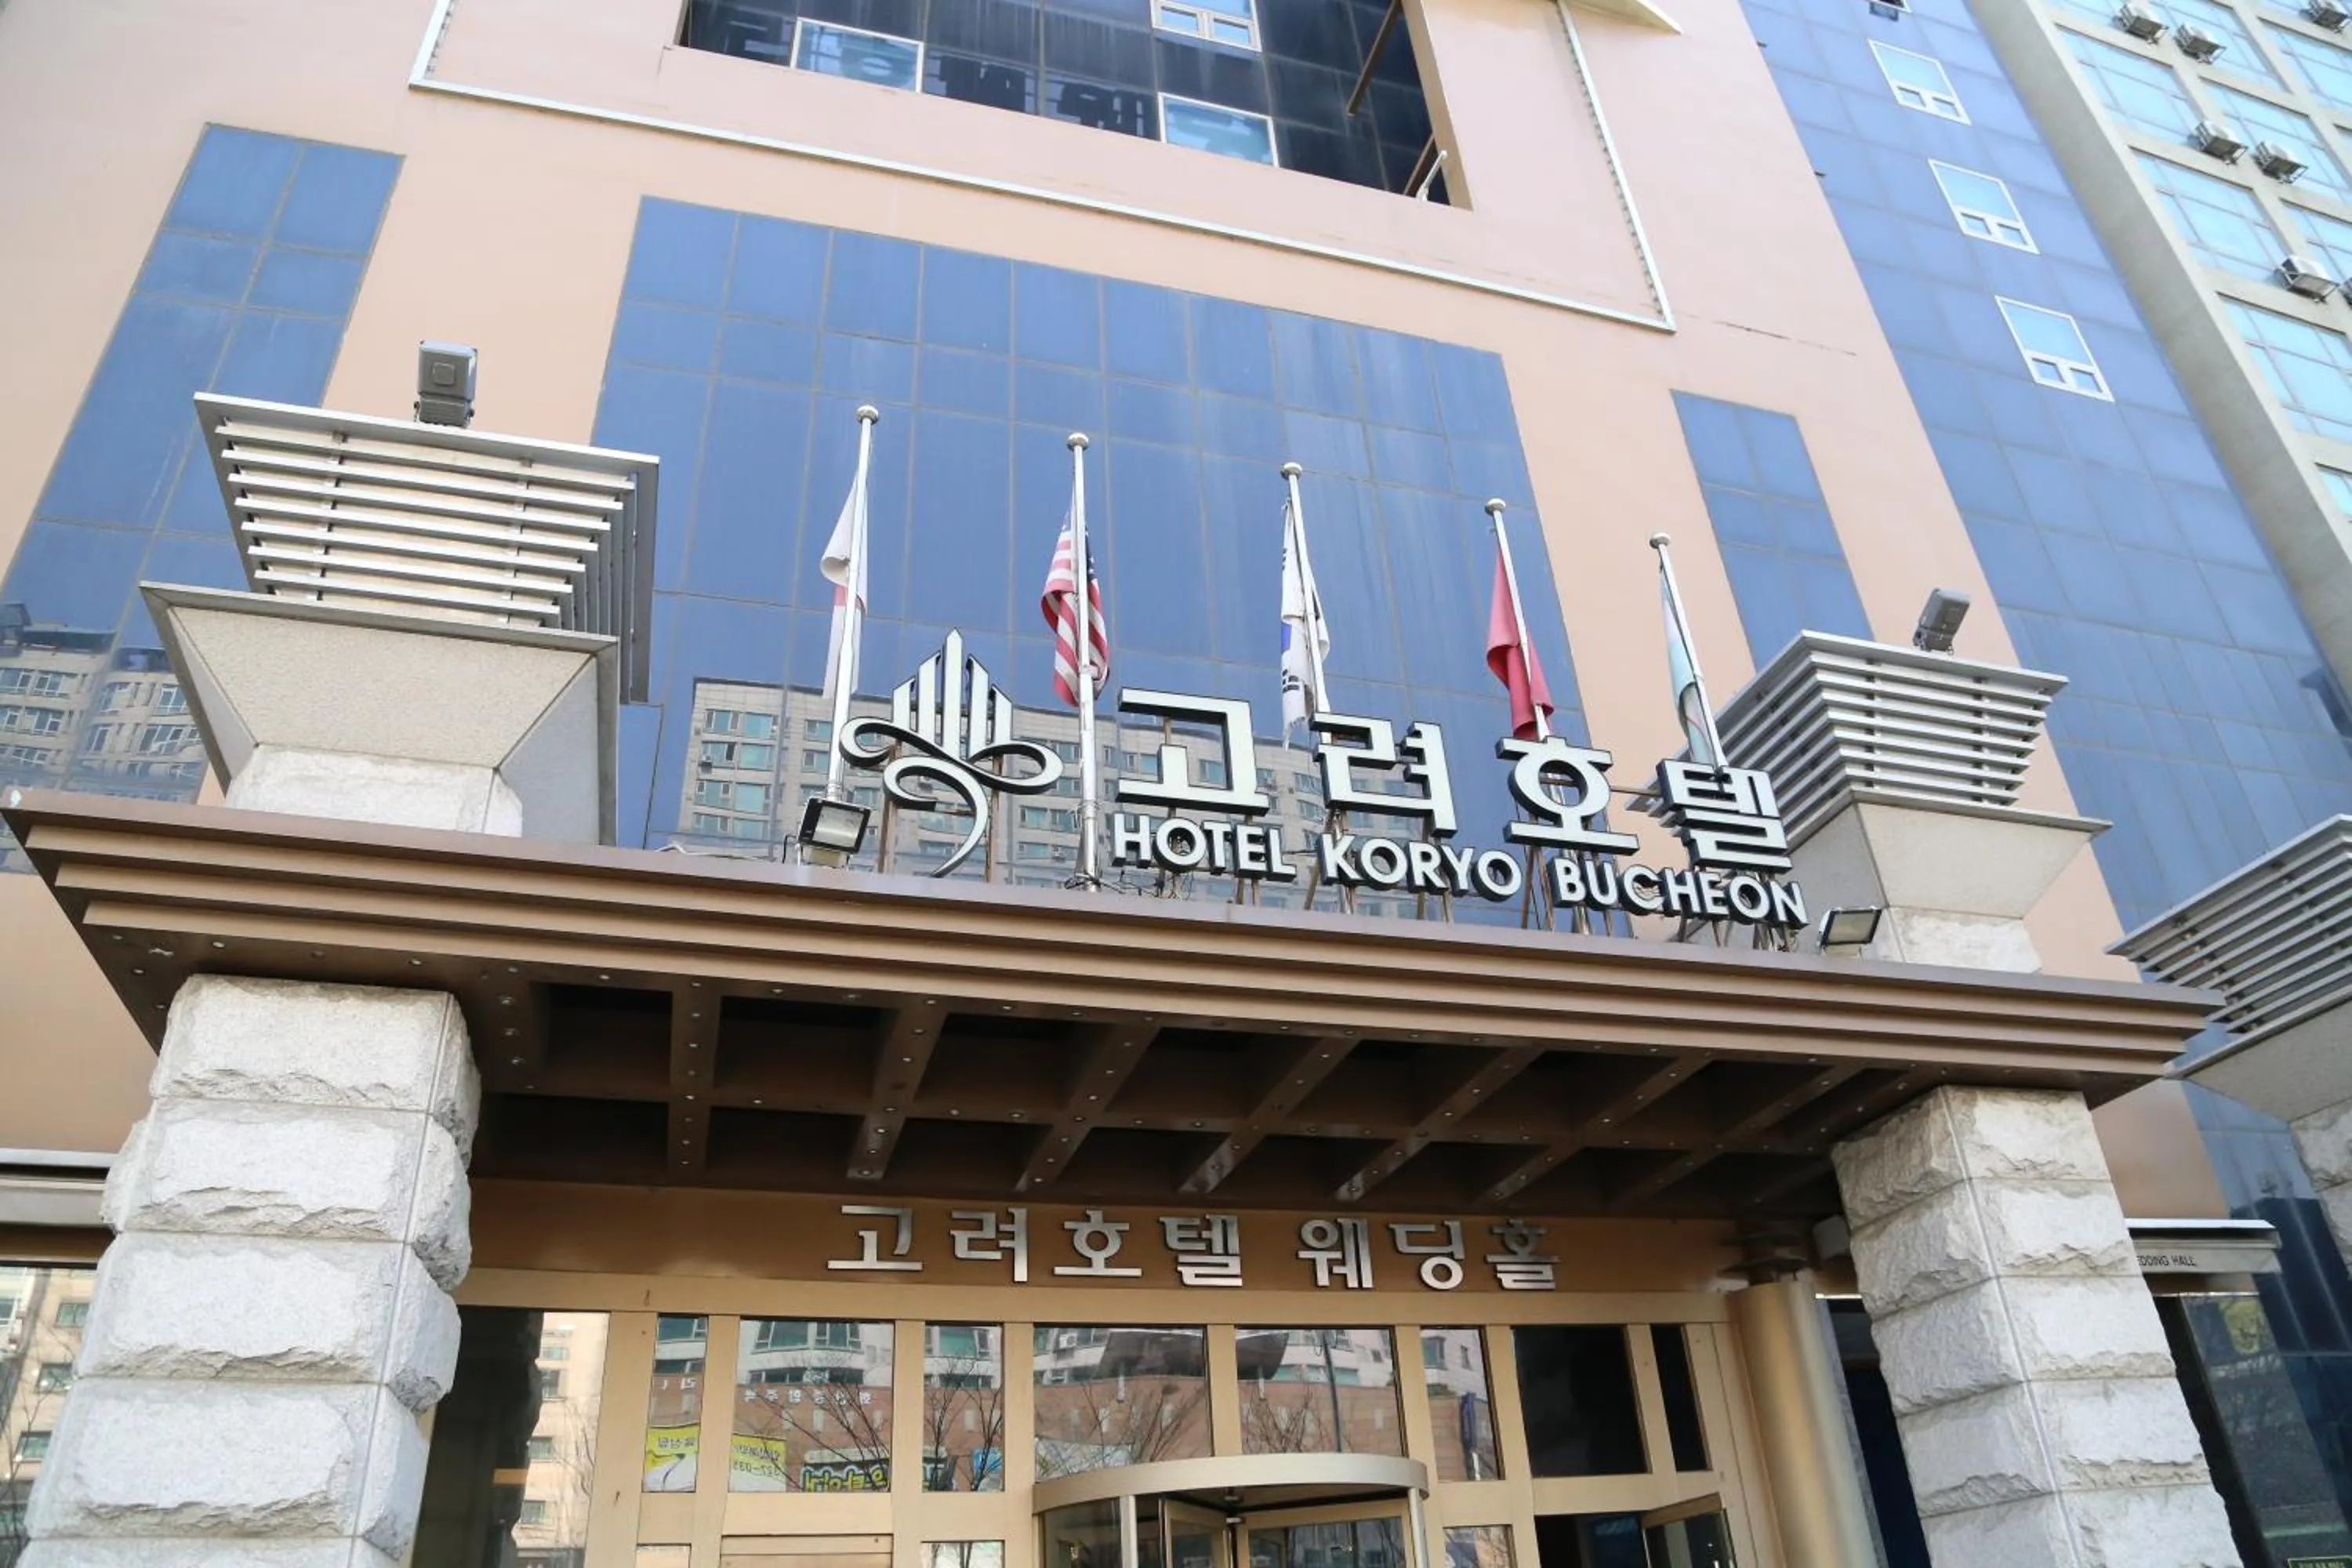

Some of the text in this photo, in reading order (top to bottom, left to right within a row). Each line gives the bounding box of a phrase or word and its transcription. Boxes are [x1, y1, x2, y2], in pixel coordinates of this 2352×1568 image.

[1116, 688, 1792, 873] 고려호텔
[1113, 813, 1809, 928] HOTEL KORYO BUCHEON
[827, 1205, 1561, 1291] 고려호텔 웨딩홀
[2136, 1254, 2197, 1266] EDDING HALL
